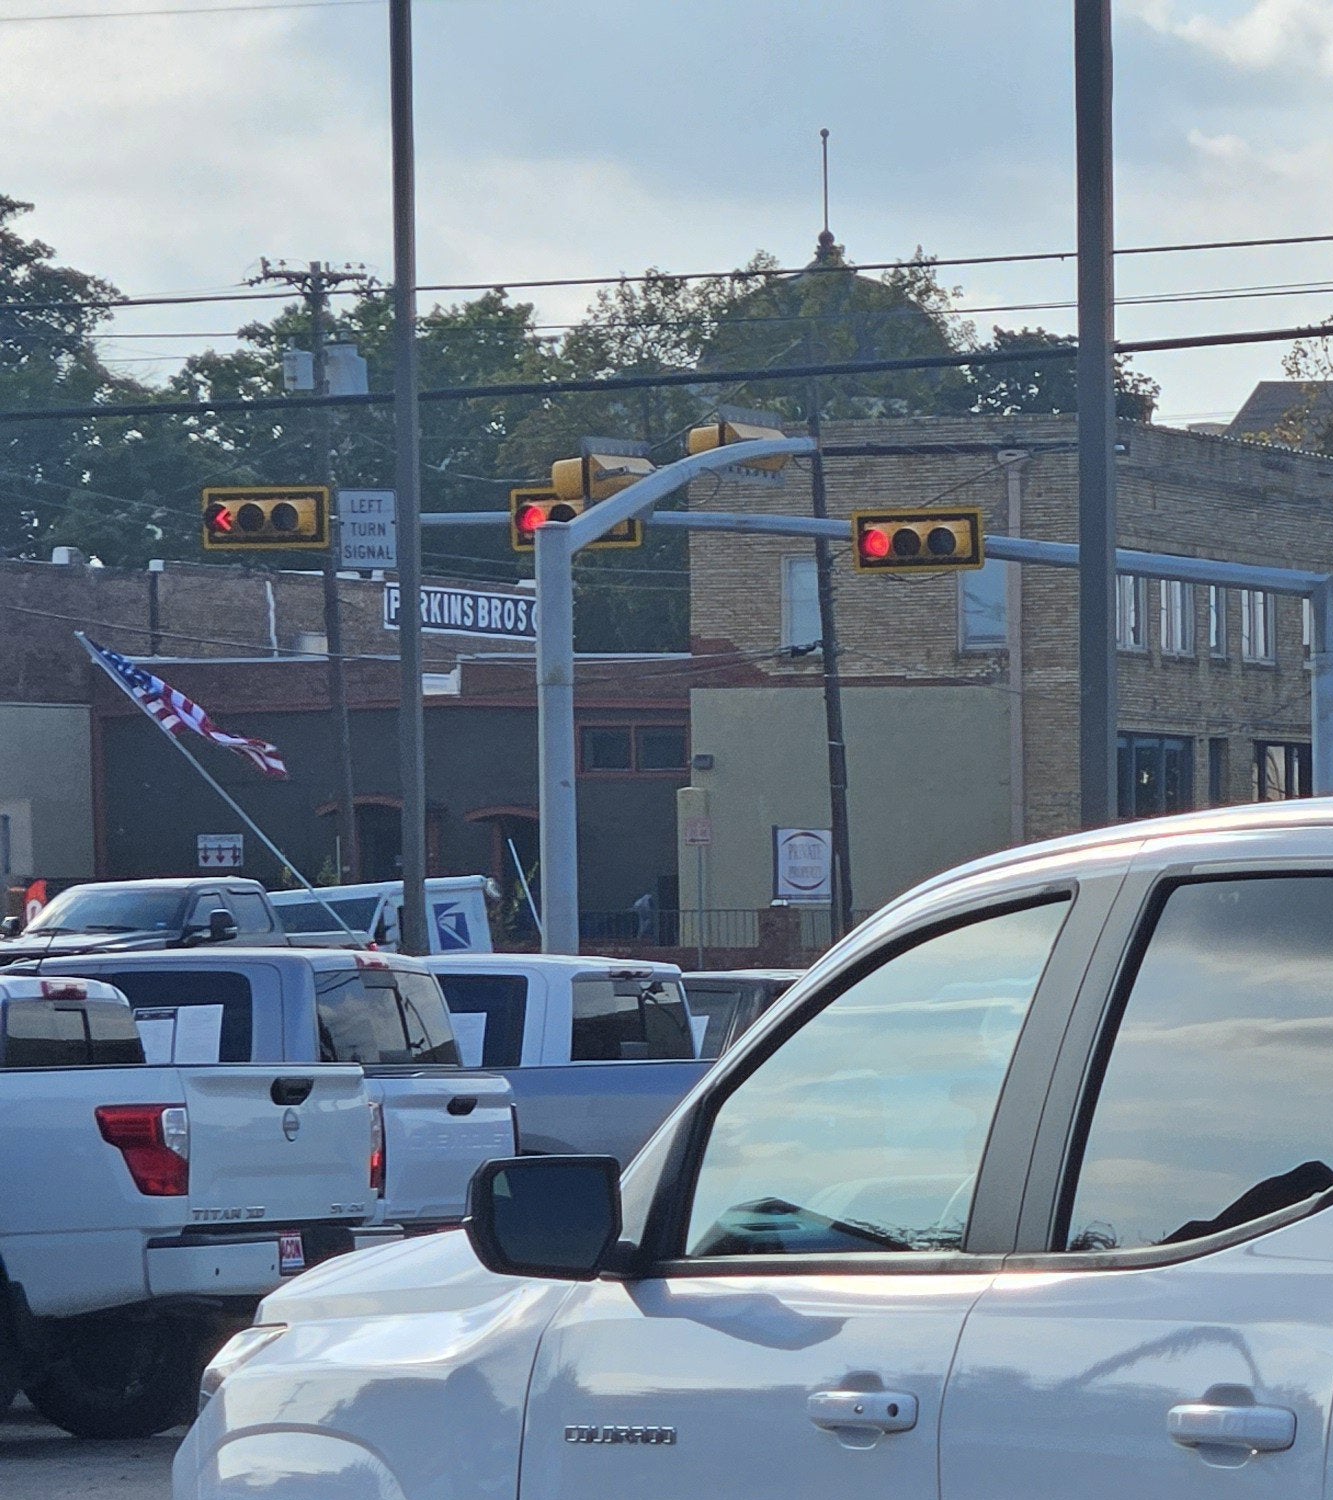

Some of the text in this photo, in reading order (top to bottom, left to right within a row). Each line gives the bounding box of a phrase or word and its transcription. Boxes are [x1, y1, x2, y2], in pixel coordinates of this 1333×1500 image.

[350, 500, 383, 514] LEFT
[350, 522, 386, 537] TURN
[344, 545, 393, 560] SIGNAL
[389, 587, 475, 627] PRKINS
[477, 598, 528, 632] BROS
[192, 1207, 242, 1221] TITAN
[565, 1425, 677, 1444] COLORADO
